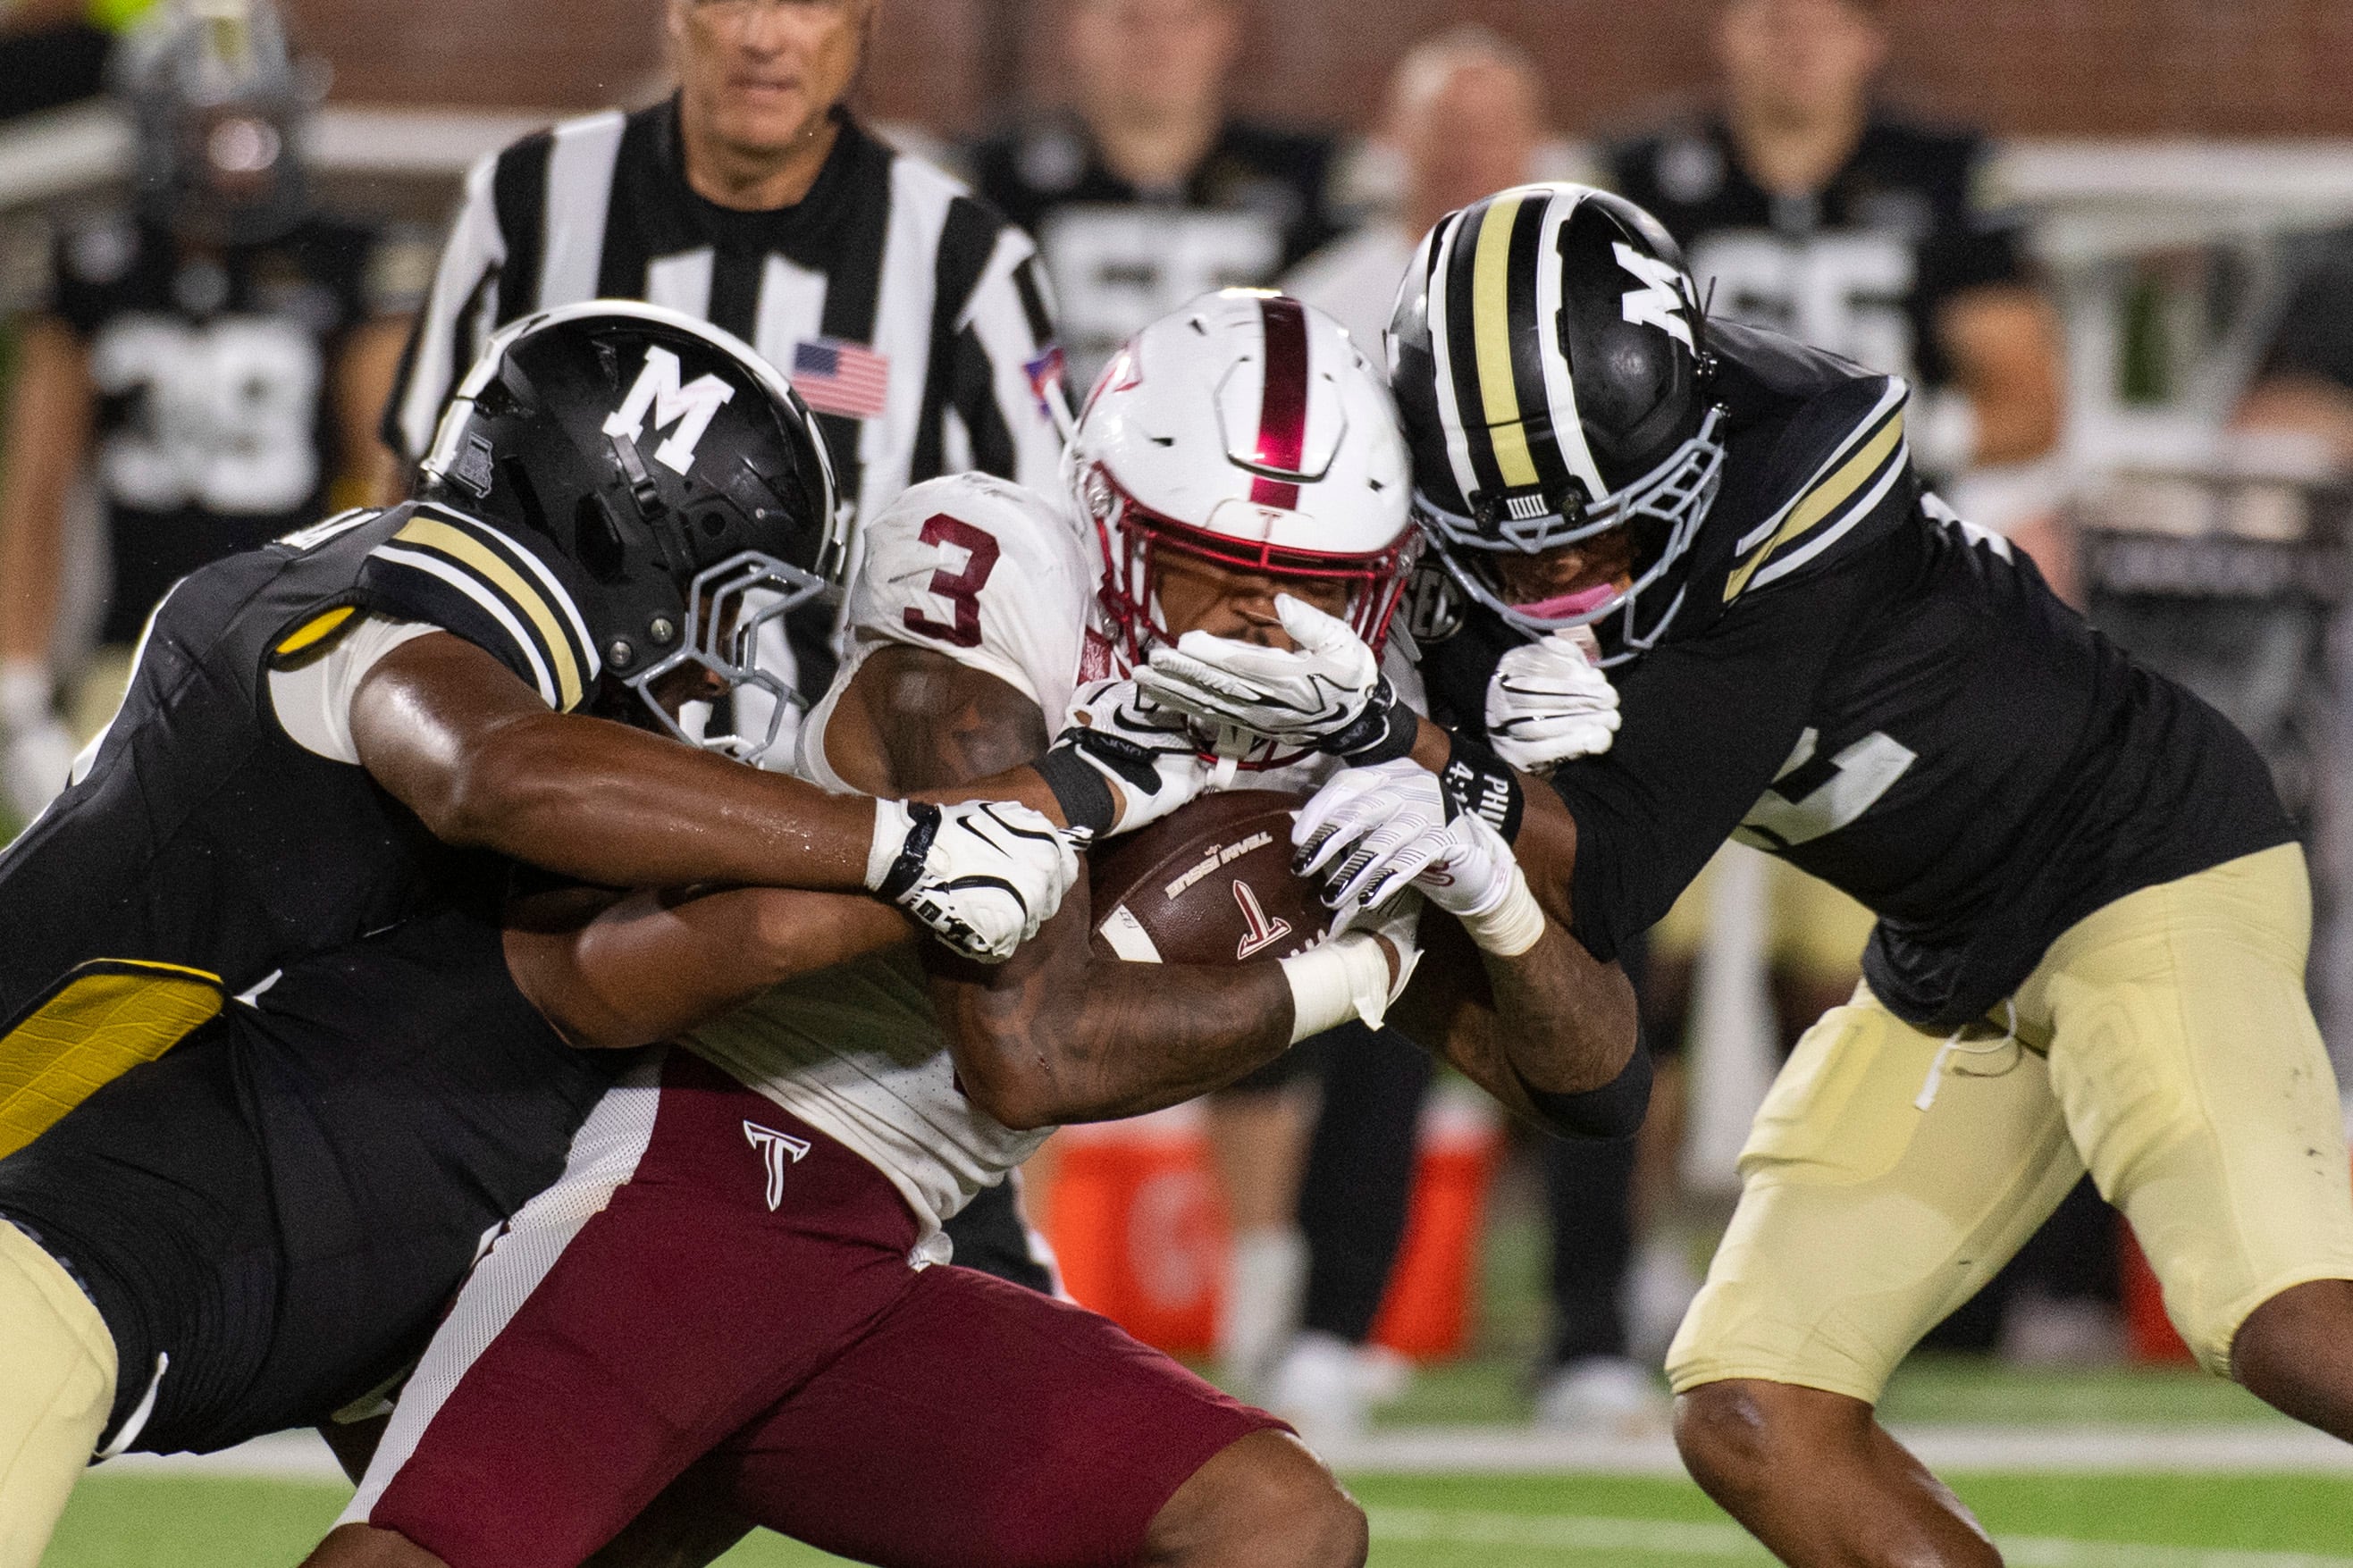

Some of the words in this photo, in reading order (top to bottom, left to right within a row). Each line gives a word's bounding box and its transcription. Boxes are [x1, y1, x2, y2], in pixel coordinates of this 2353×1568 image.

[601, 345, 735, 476] M
[903, 512, 1001, 649] 3
[1164, 854, 1222, 901] ISSUE
[1219, 831, 1273, 865] TEAM
[1232, 879, 1292, 960] T
[743, 1119, 811, 1213] T
